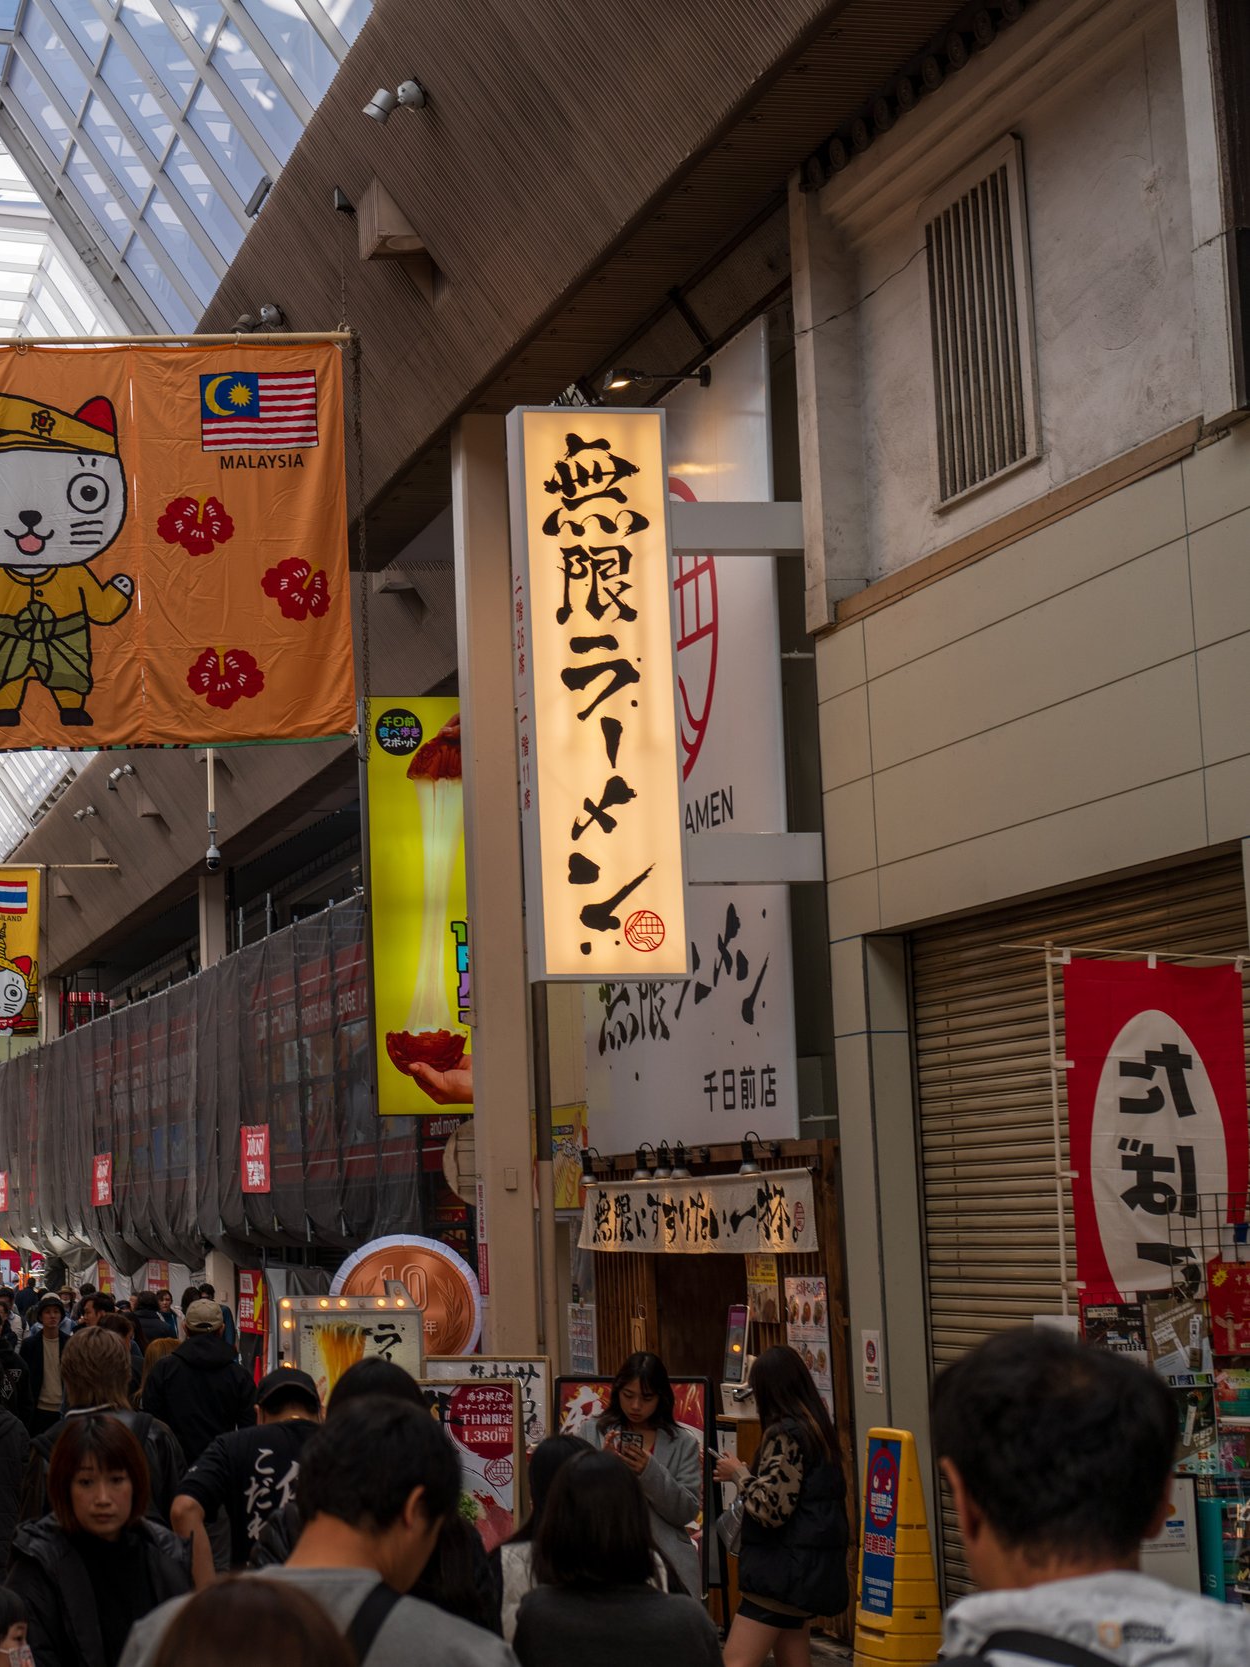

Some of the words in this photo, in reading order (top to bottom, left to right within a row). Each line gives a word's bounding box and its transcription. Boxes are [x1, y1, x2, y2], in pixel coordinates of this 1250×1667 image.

[219, 453, 305, 470] MALAYSIA
[542, 432, 656, 945] 無限ラーメン
[381, 715, 417, 728] 千日前
[379, 726, 421, 738] 食べ歩き
[381, 736, 417, 748] スポット
[684, 785, 735, 836] AMEN
[703, 1064, 777, 1113] 千日前店
[380, 1263, 428, 1313] 10
[460, 1413, 513, 1426] 千日前限定
[463, 1431, 509, 1443] 1,380円
